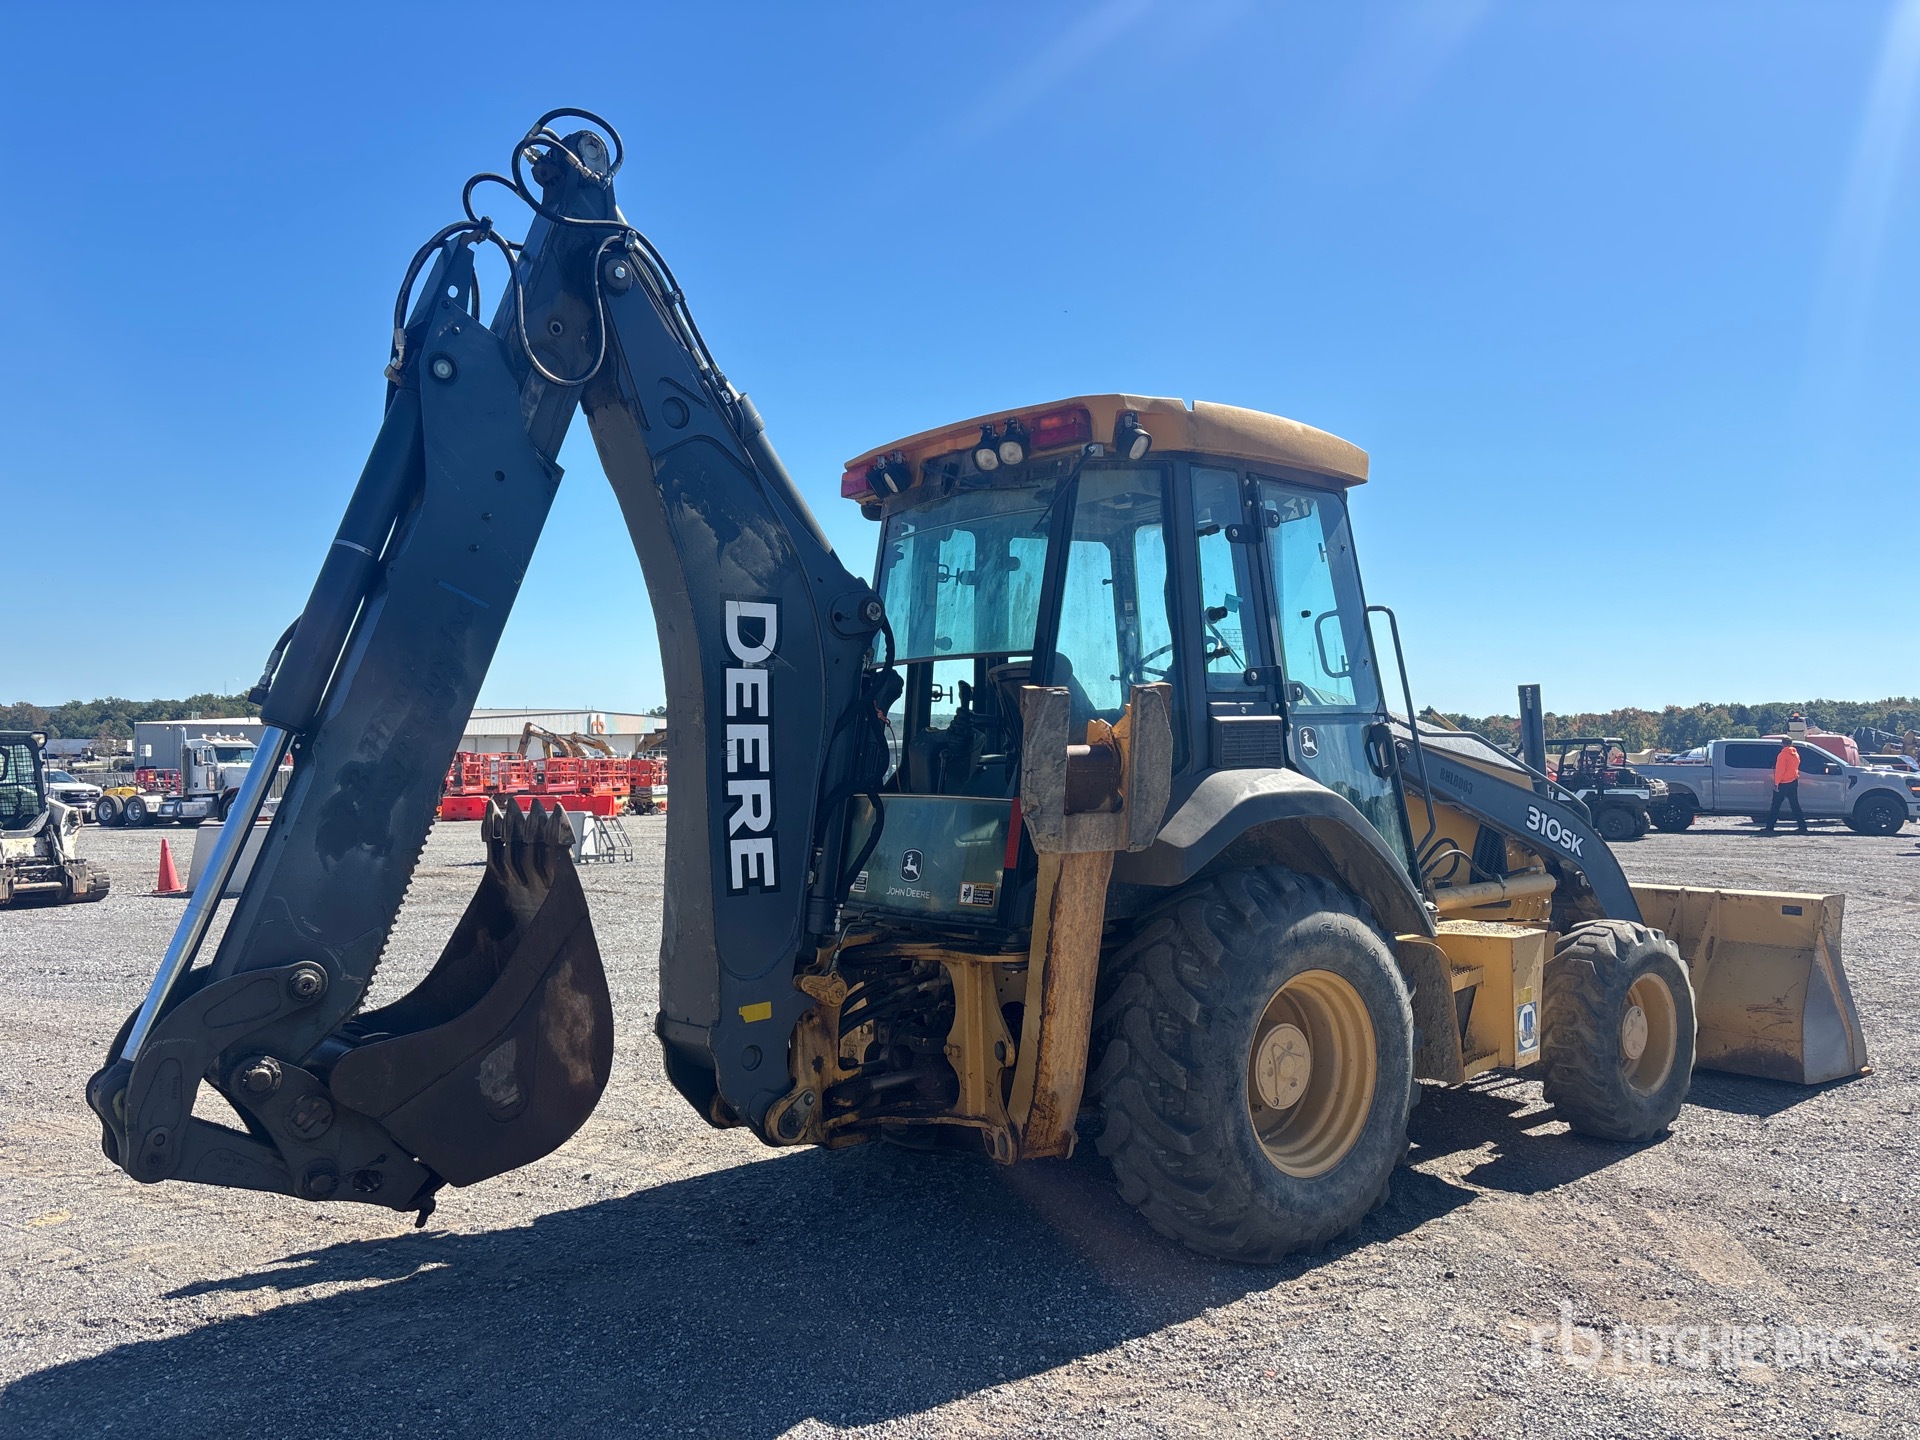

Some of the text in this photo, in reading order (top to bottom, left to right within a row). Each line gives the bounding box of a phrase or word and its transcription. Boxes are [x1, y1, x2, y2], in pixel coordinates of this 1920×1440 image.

[725, 600, 777, 889] DEERE
[1525, 805, 1585, 858] 310SK
[886, 885, 931, 899] JOHN DEERE
